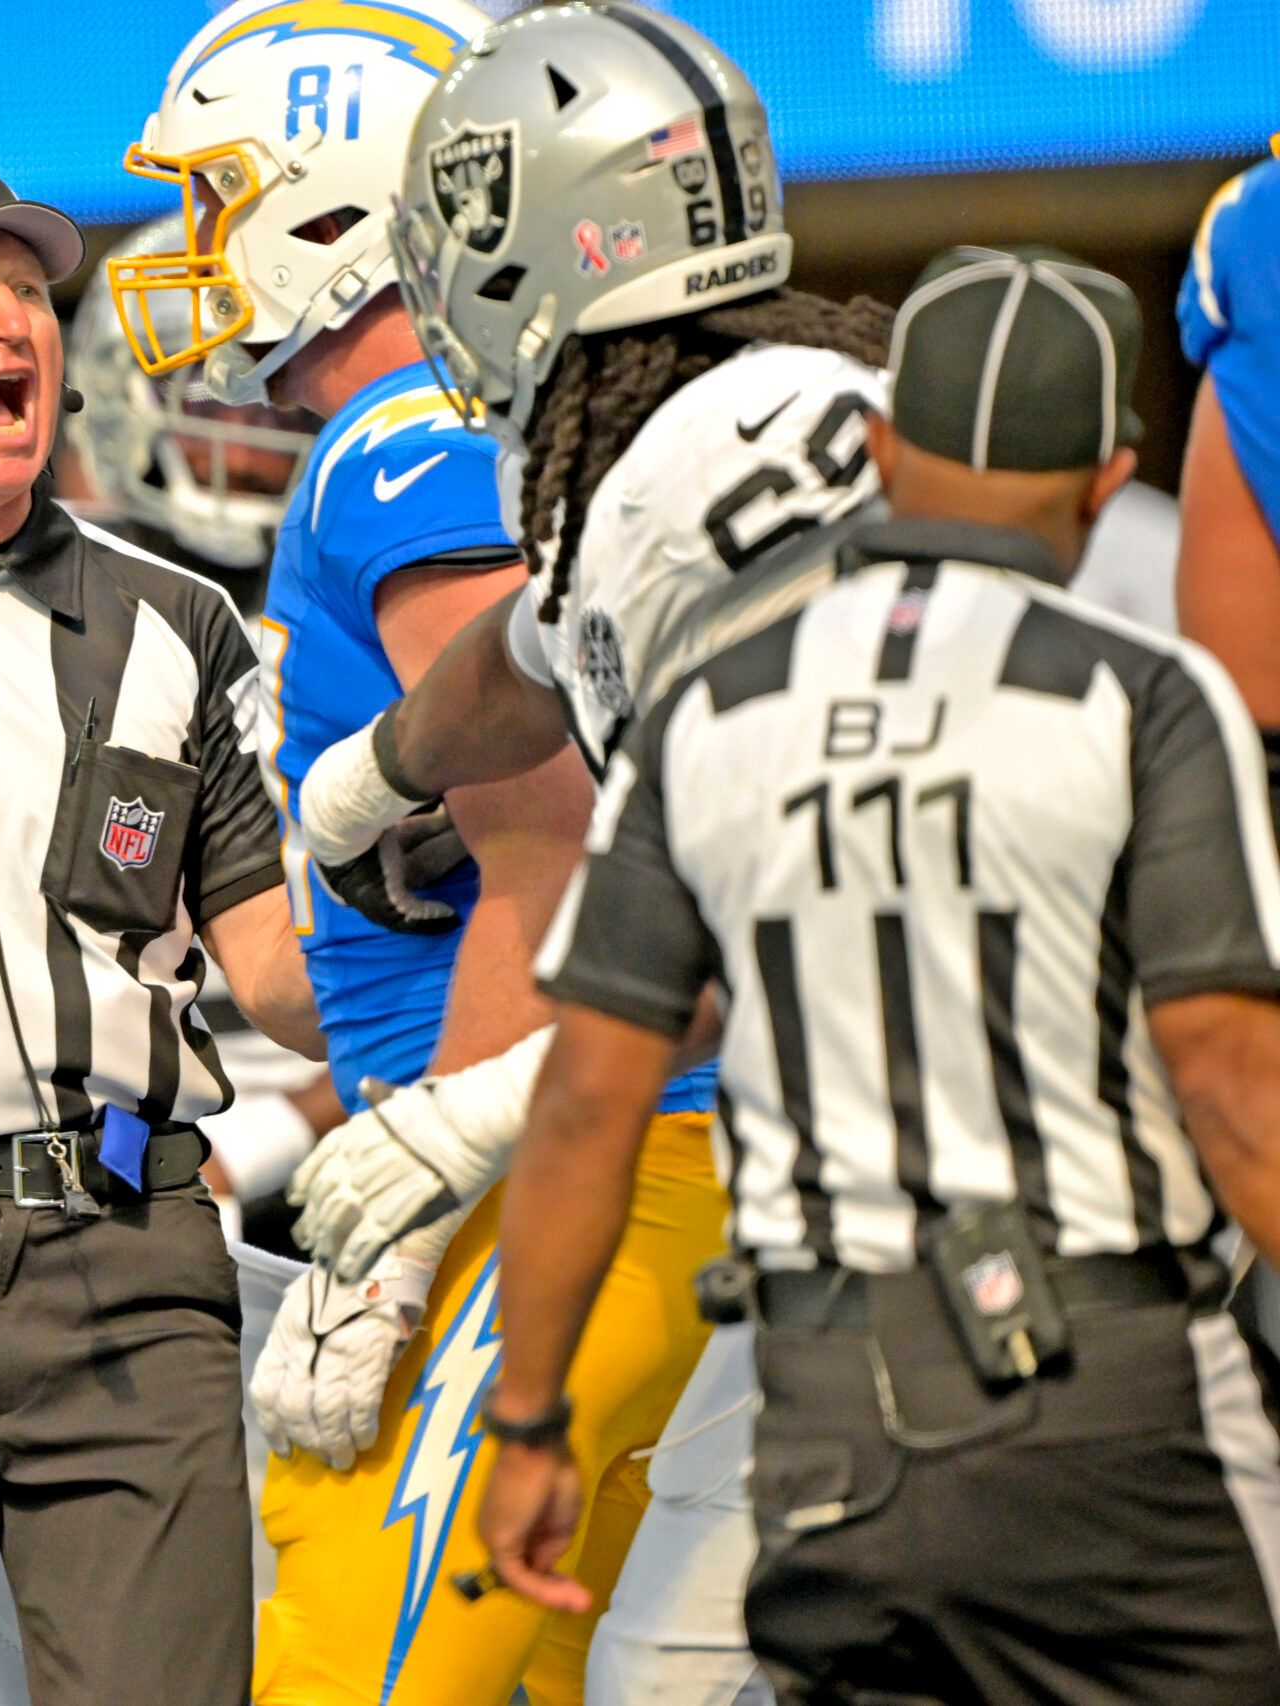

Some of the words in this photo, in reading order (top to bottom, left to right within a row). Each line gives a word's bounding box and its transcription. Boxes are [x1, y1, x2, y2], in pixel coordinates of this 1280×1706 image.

[285, 64, 363, 141] 81
[686, 200, 716, 247] 6
[686, 253, 778, 296] RAIDERS
[823, 695, 947, 759] BJ
[107, 822, 147, 861] NFL
[782, 774, 973, 889] 111
